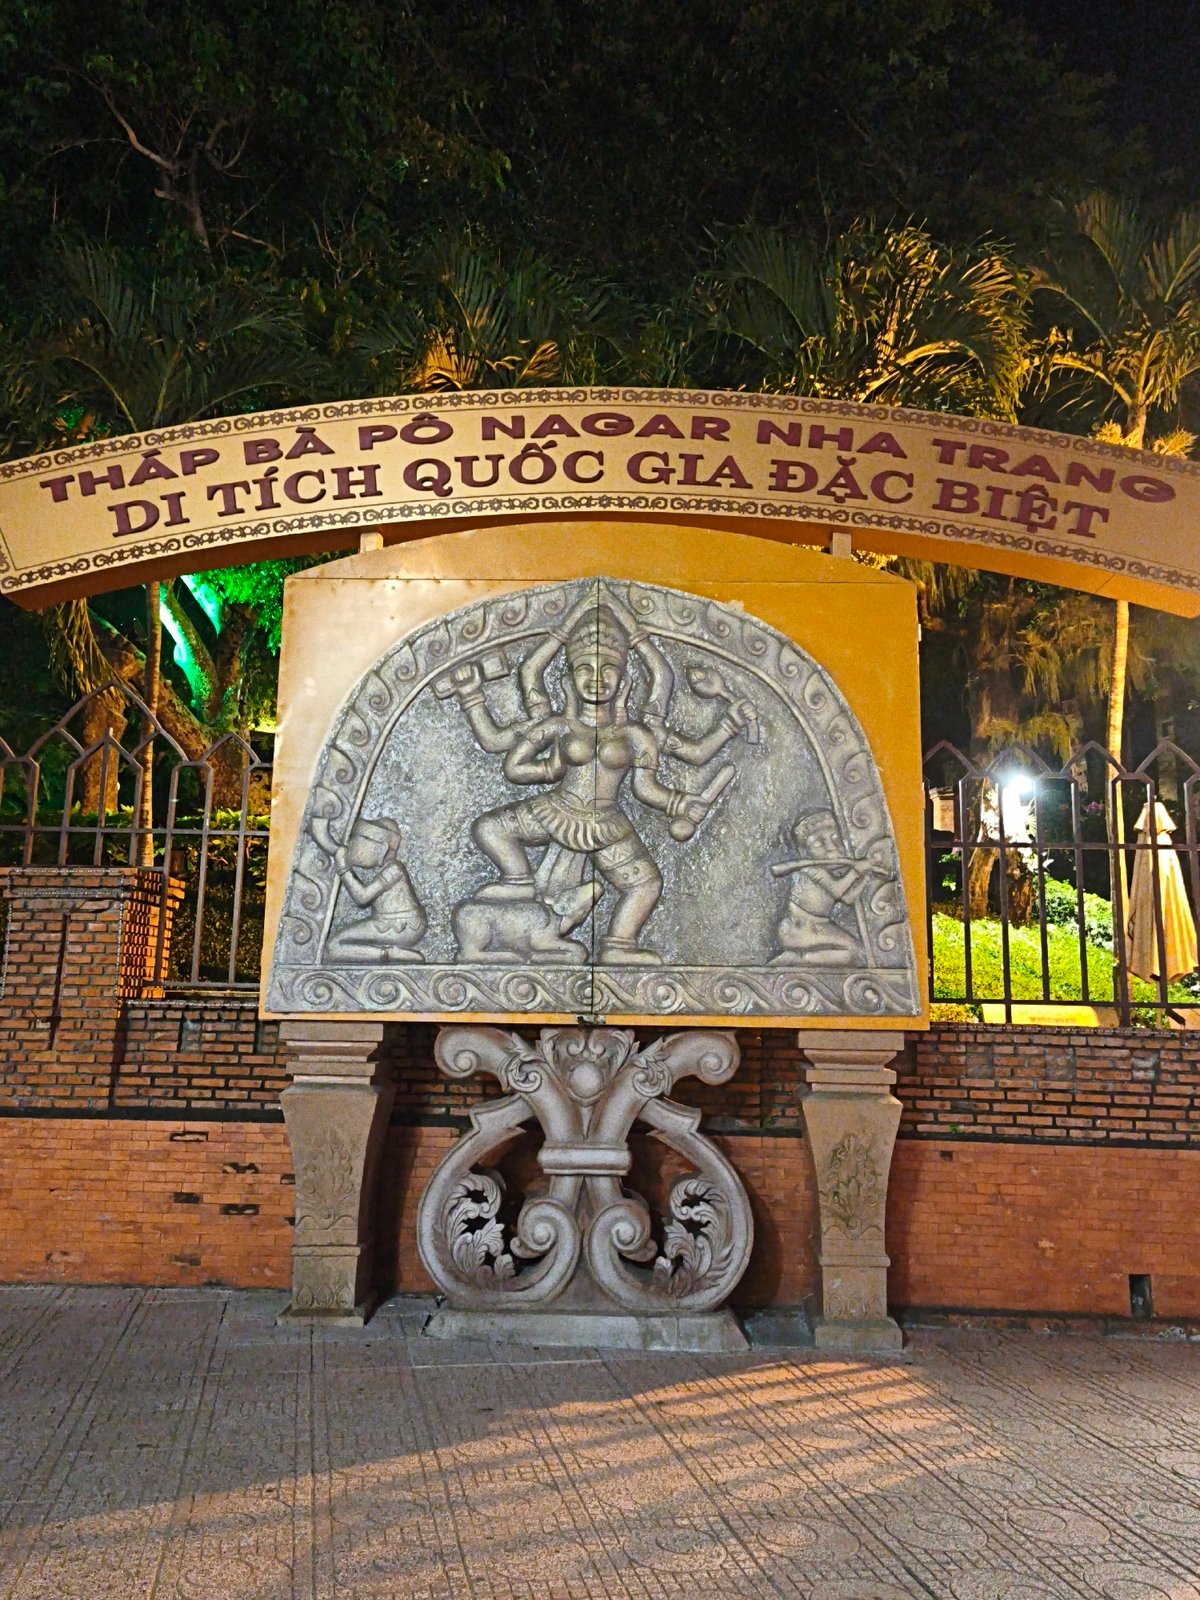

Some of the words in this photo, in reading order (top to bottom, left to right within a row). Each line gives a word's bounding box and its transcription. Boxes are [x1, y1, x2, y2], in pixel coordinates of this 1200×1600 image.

[40, 448, 220, 502] THÁP
[358, 412, 454, 451] PÔ
[481, 412, 731, 442] NAGAR
[756, 419, 908, 459] NHA
[932, 438, 1176, 503] TRANG
[107, 491, 190, 538] DI
[207, 464, 383, 517] TÍCH
[402, 439, 605, 498] QUỐC
[626, 450, 753, 489] GIA
[767, 455, 914, 504] ĐẶC
[931, 477, 1110, 539] BIỆT
